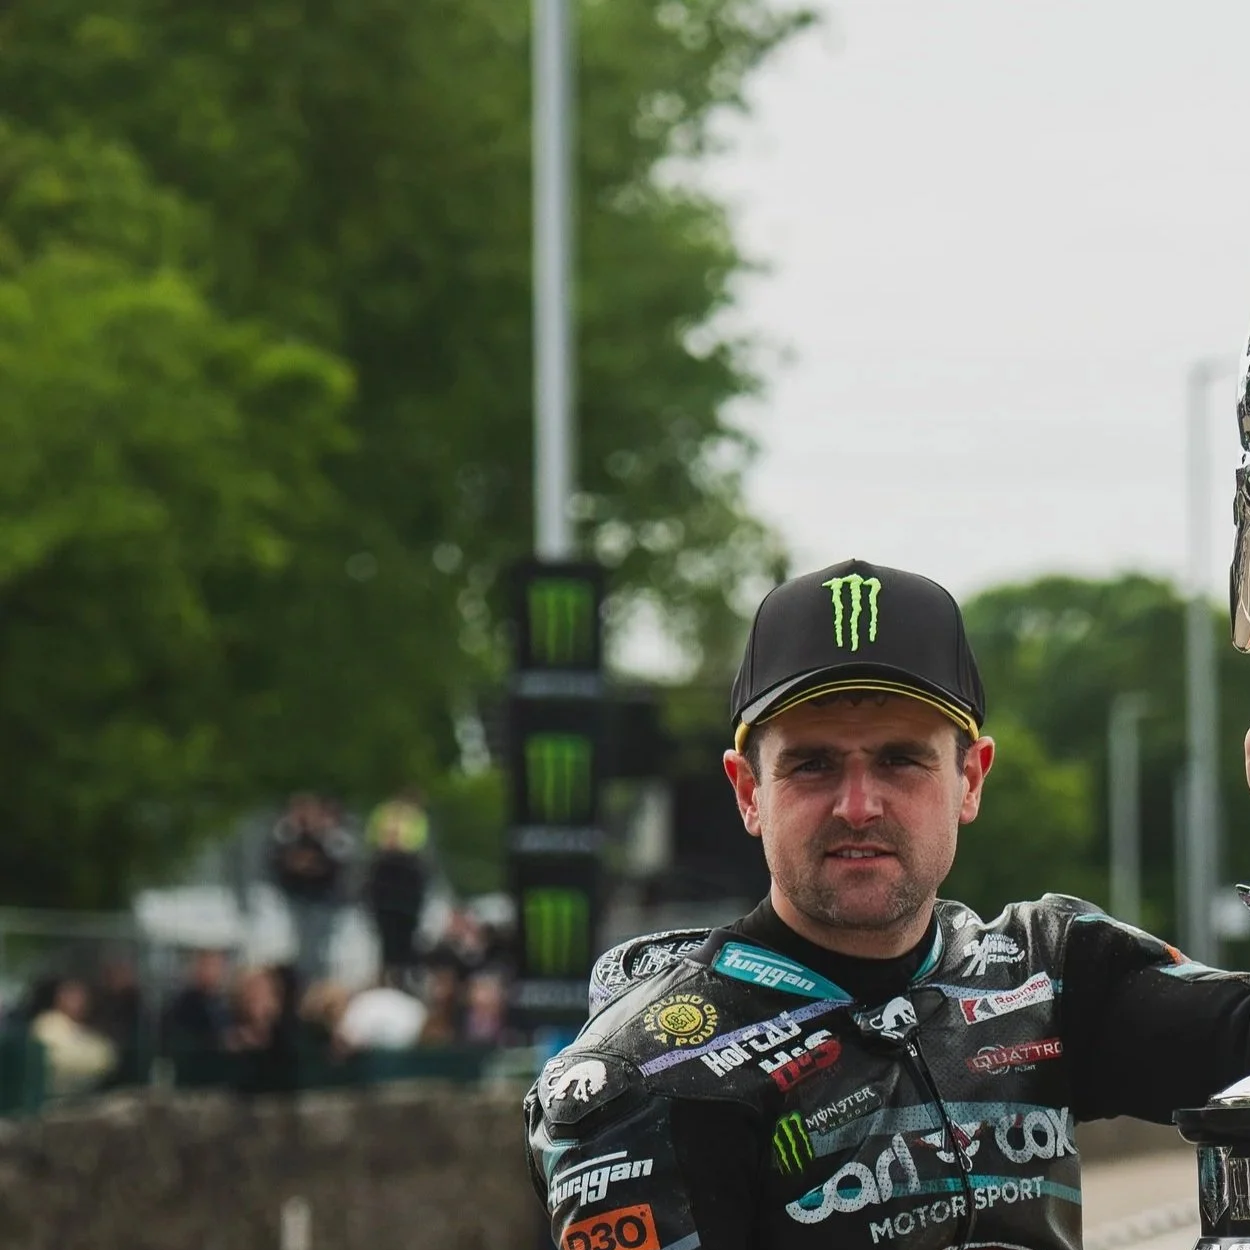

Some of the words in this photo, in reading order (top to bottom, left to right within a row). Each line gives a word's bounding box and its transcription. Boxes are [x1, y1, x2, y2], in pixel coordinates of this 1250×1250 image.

[723, 948, 816, 991] furygan
[994, 980, 1050, 1005] Robinson
[805, 1086, 876, 1129] MONSTER
[548, 1151, 654, 1210] furygan
